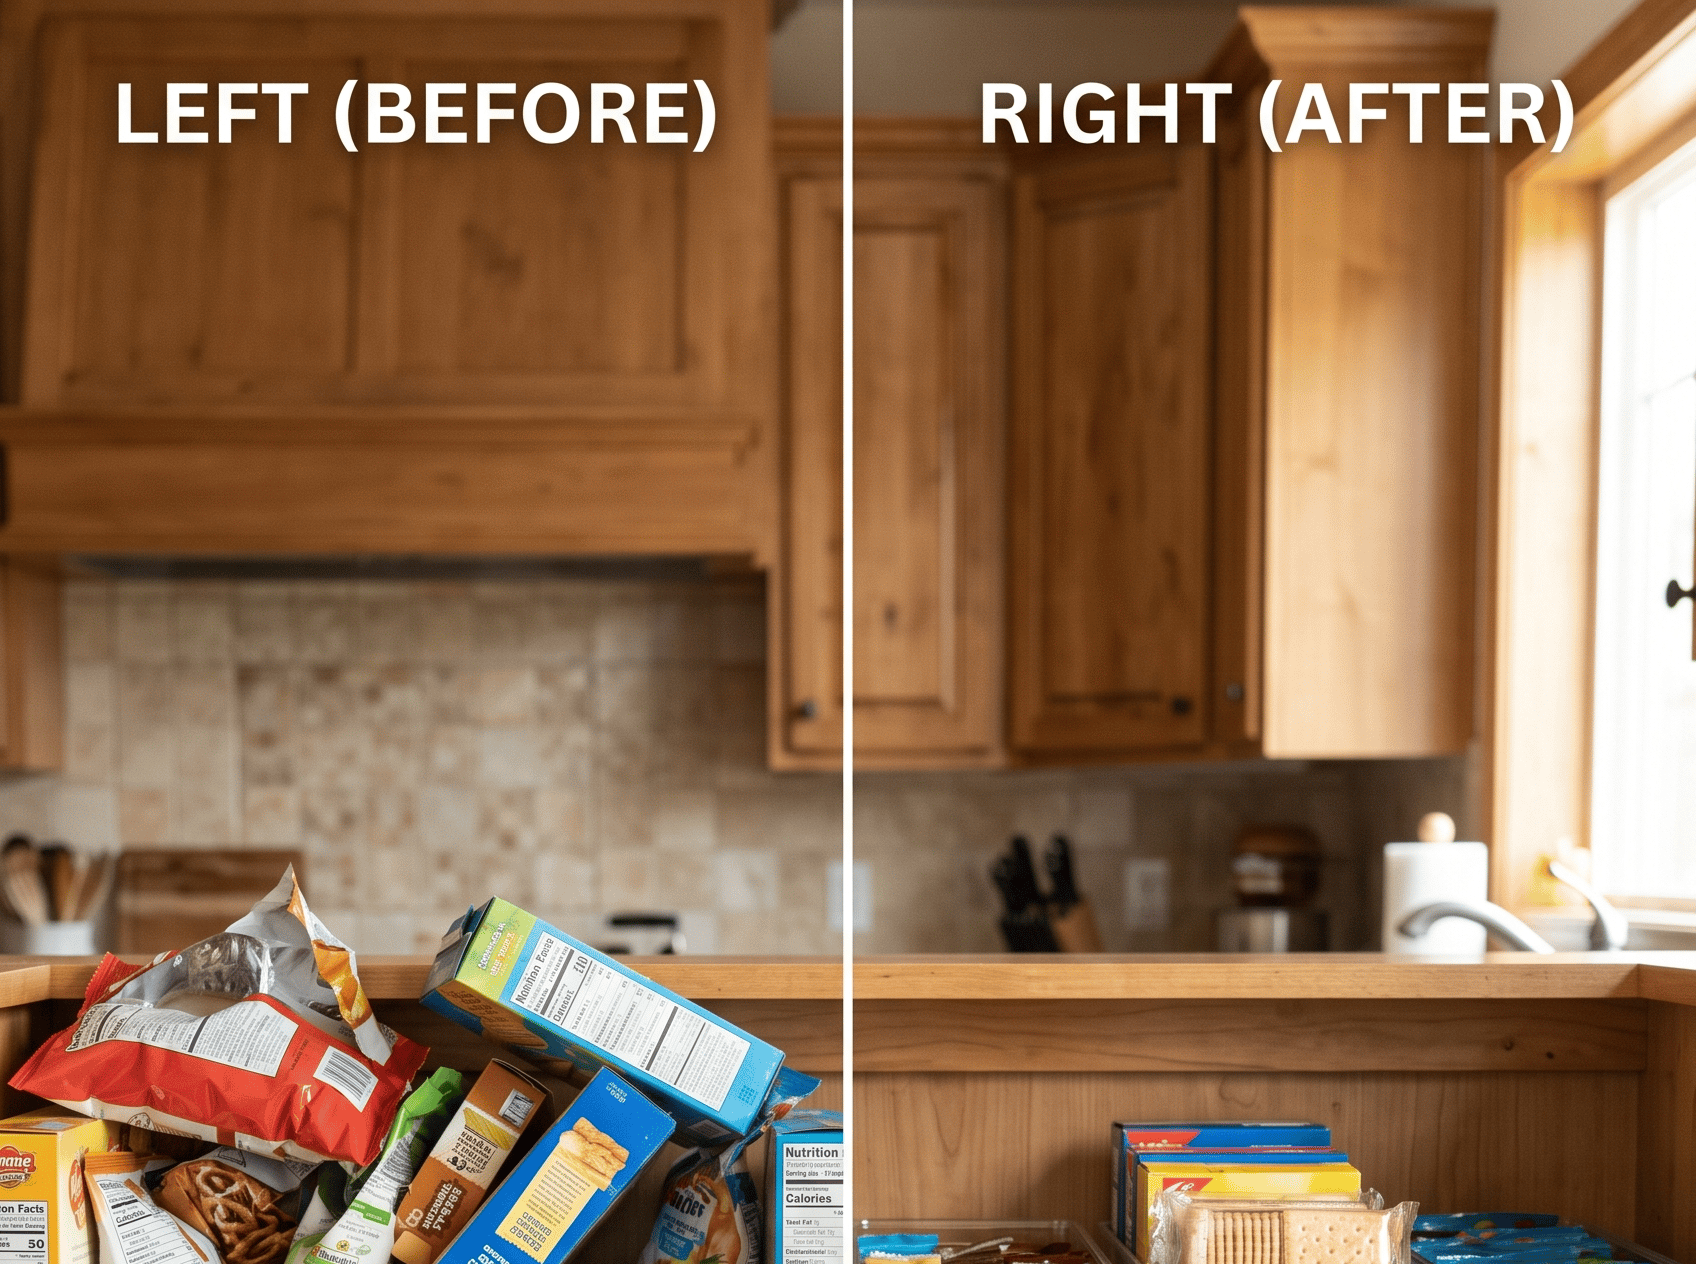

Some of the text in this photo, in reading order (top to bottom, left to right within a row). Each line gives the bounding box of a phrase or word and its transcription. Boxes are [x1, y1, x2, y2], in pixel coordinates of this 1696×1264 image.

[785, 1146, 839, 1158] Nutrition
[785, 1193, 832, 1204] Calories
[17, 1203, 45, 1214] Facts
[28, 1238, 45, 1249] 50
